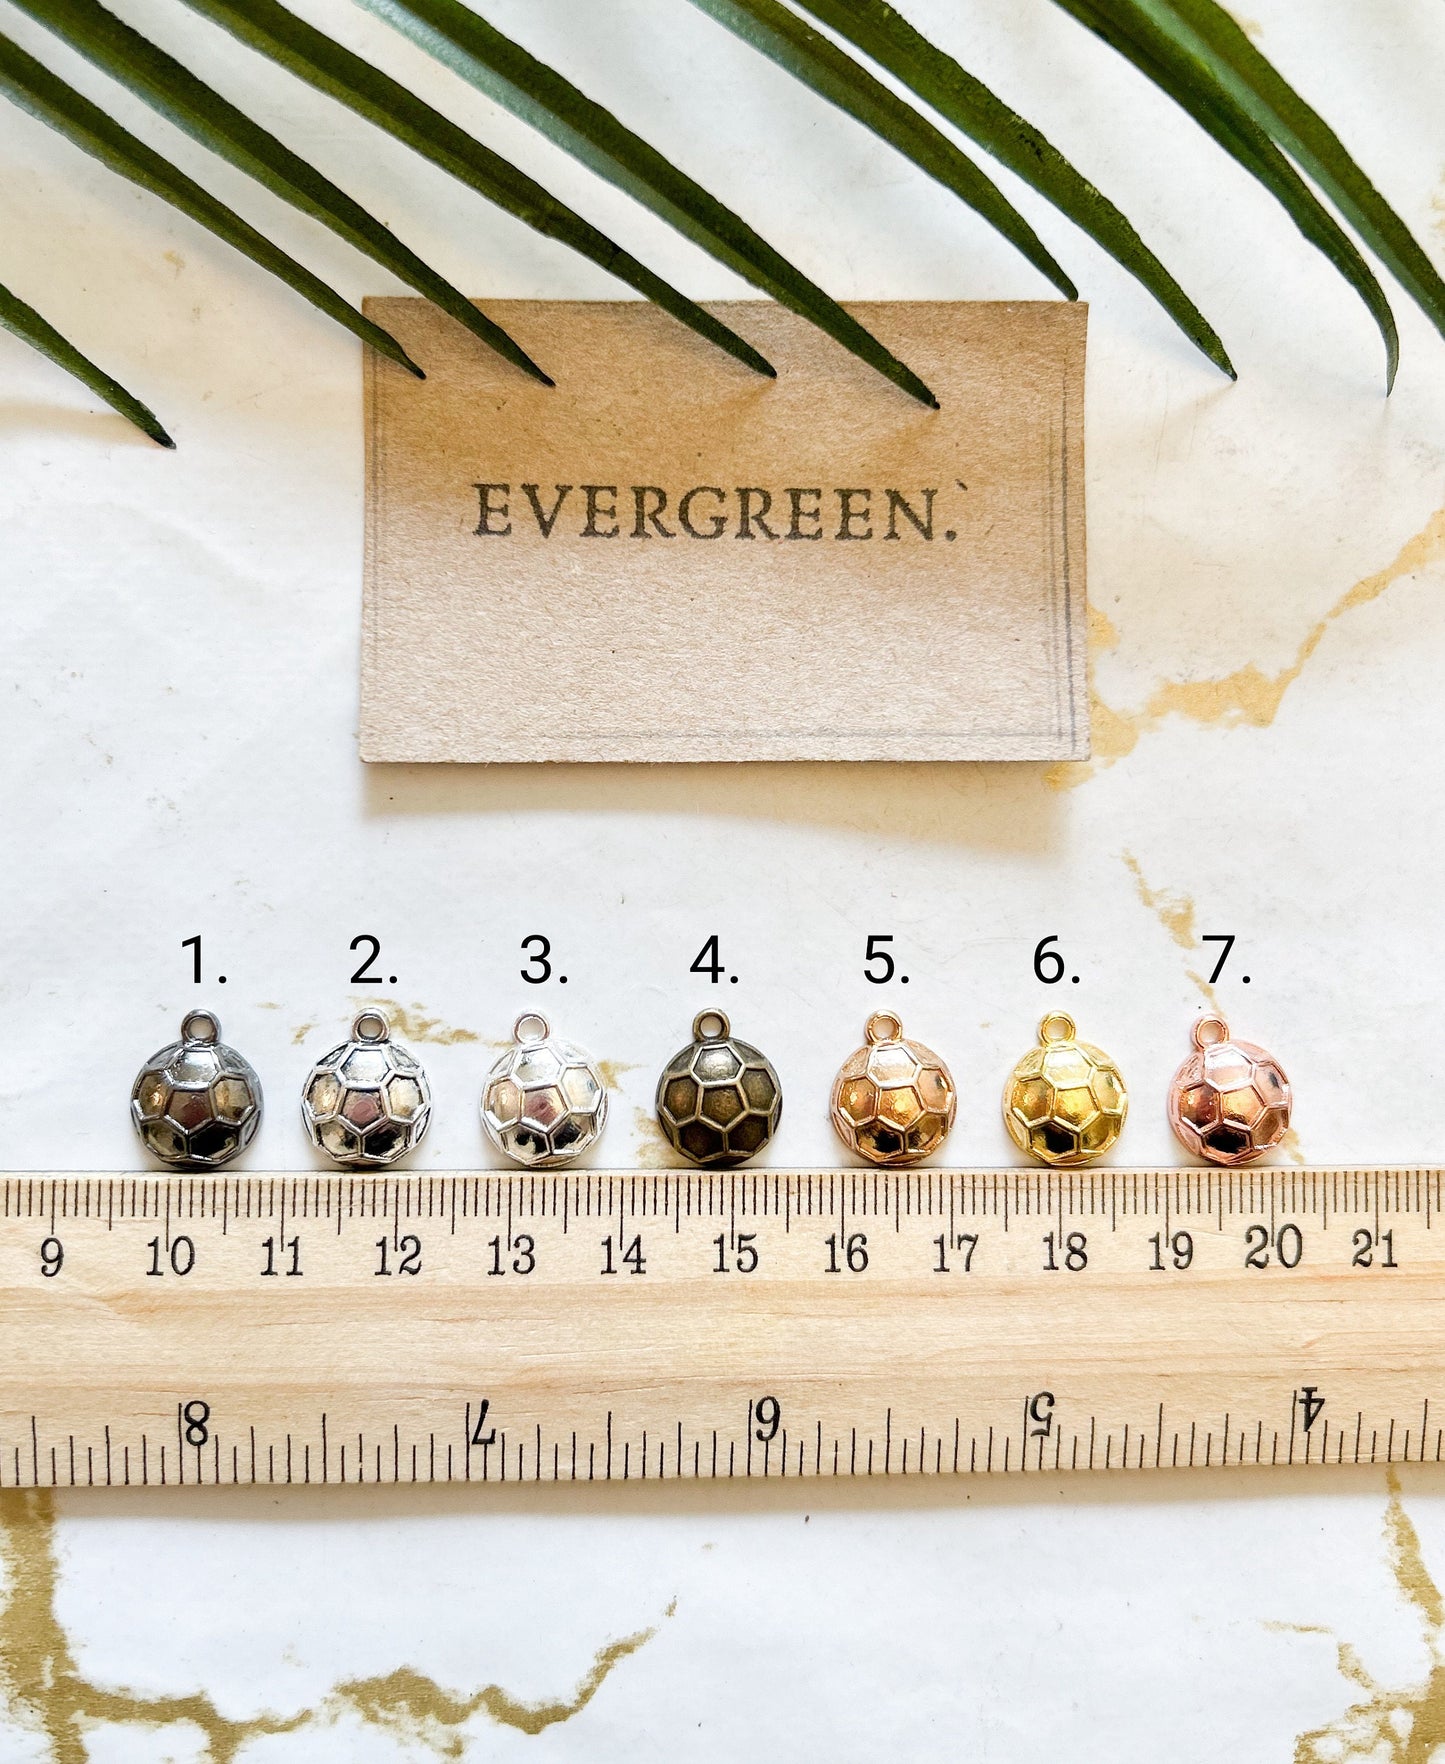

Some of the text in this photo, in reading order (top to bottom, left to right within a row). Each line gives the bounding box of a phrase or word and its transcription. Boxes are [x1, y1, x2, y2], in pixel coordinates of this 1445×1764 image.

[471, 483, 957, 541] EVERGREEN.
[41, 1223, 1397, 1277] 9 10 11 12 13 14 15 16 17 18 19 20 21
[184, 1401, 210, 1446] 8
[472, 1399, 497, 1446] 7
[1030, 1391, 1055, 1438] 5
[1299, 1387, 1326, 1432] 4
